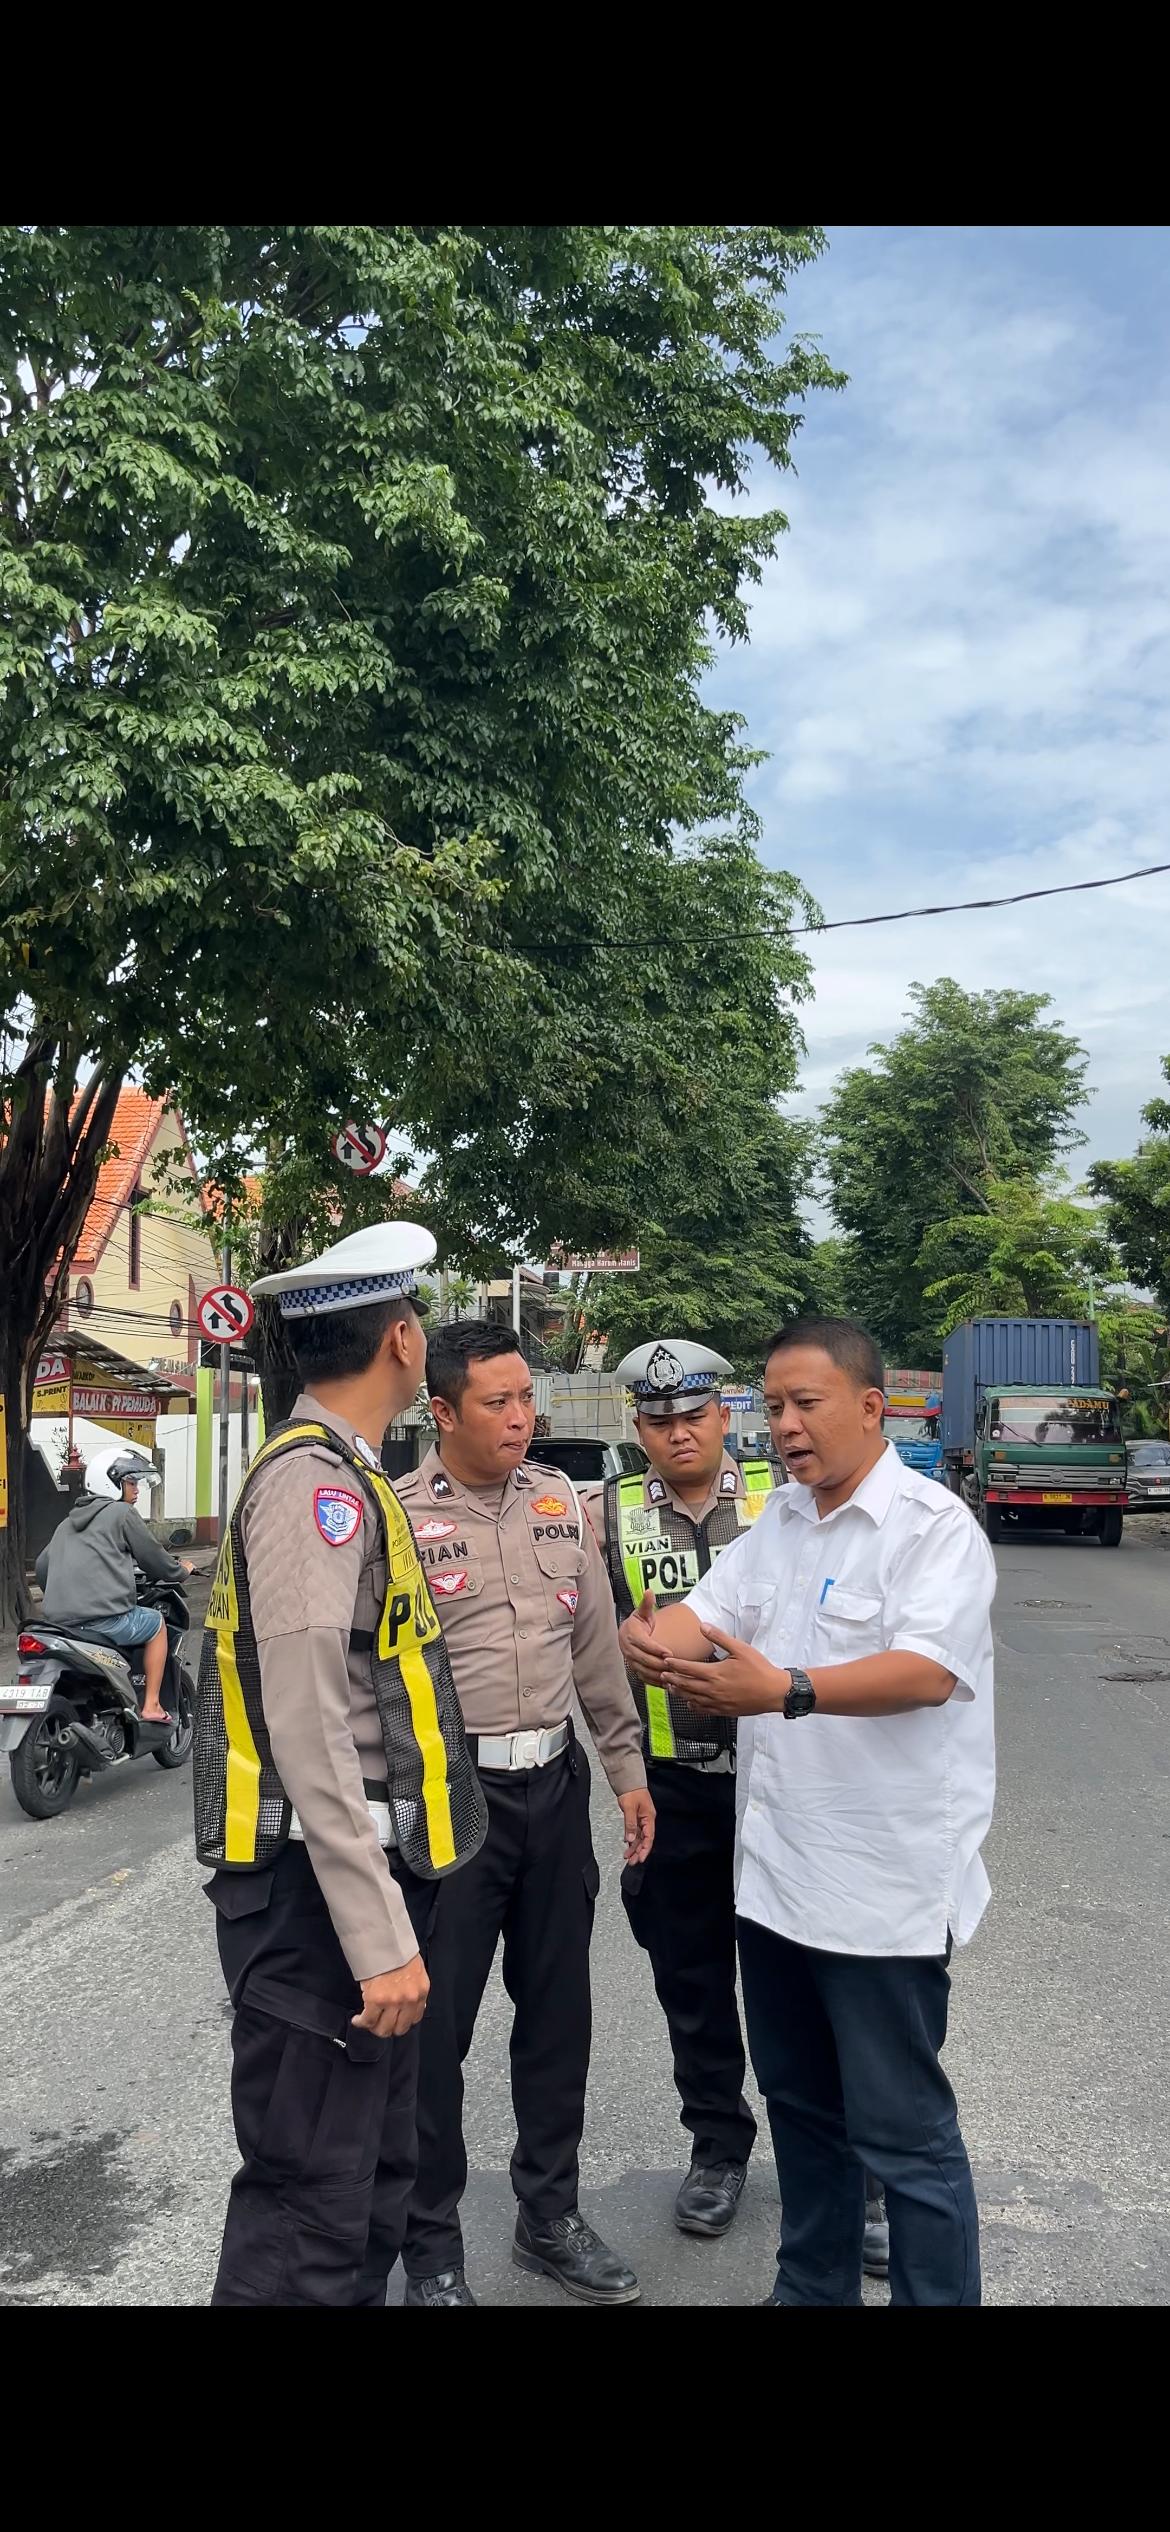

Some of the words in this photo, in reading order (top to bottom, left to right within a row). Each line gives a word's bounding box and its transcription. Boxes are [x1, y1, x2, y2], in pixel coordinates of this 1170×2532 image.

[121, 1395, 156, 1413] PEMUDA
[339, 1492, 360, 1506] LINTAS
[625, 1537, 670, 1555] VIAN
